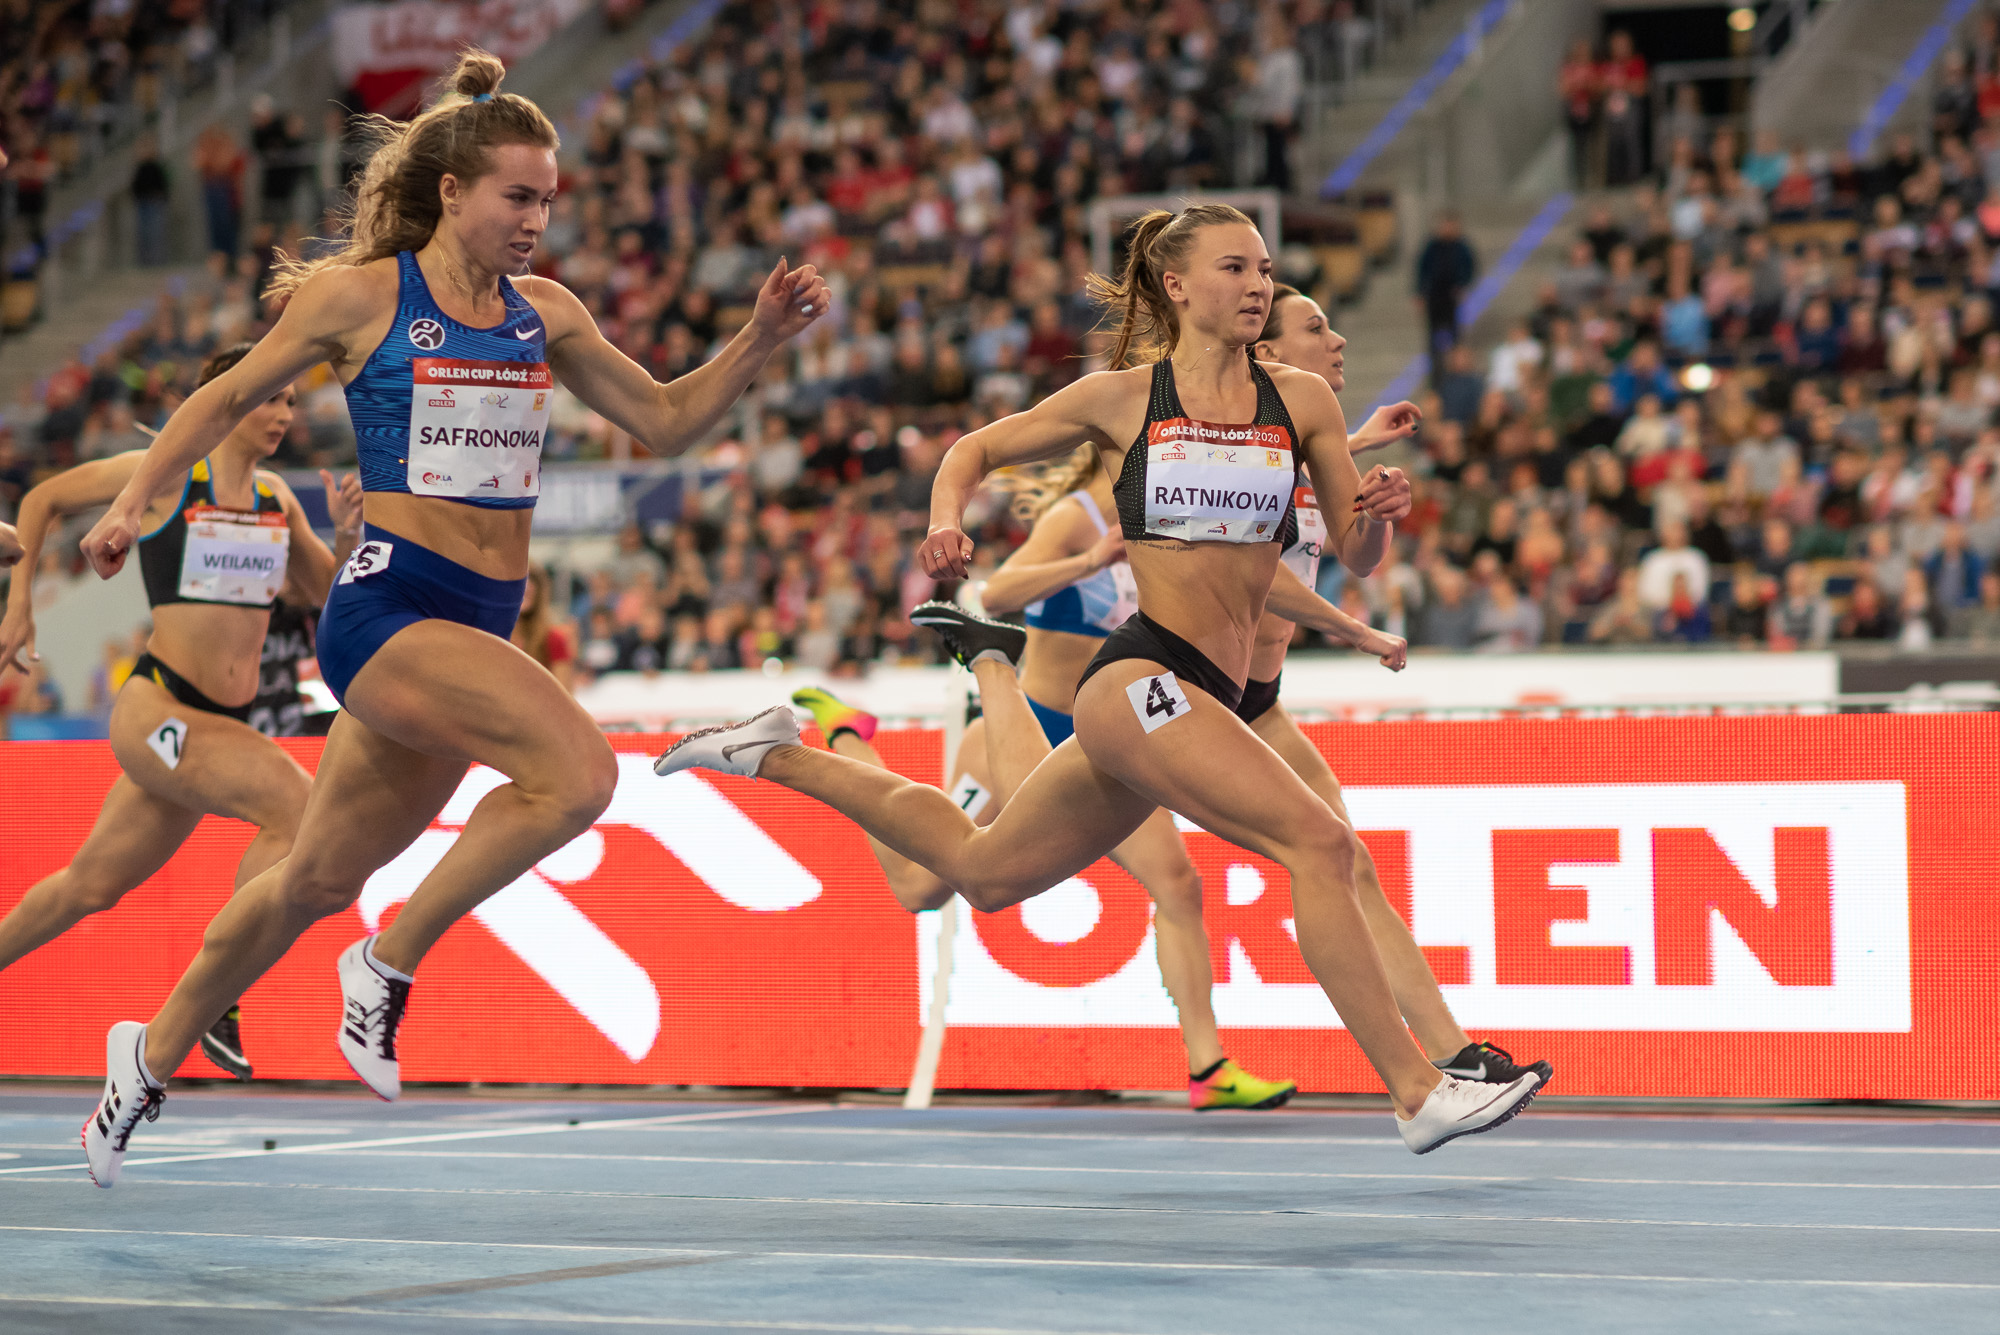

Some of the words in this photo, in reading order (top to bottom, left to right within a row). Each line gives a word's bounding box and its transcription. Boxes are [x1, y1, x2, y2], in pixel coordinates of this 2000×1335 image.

[428, 367, 469, 379] ORLEN
[471, 368, 494, 380] CUP
[496, 368, 528, 382] ŁÓDŹ
[529, 372, 547, 382] 2020
[420, 426, 540, 448] SAFRONOVA
[1160, 426, 1198, 437] ORLEN
[1200, 428, 1220, 439] CUP
[1221, 429, 1254, 440] ŁÓDŹ
[1255, 432, 1280, 443] 2020
[1155, 486, 1279, 512] RATNIKOVA
[203, 553, 275, 571] WEILAND
[1145, 676, 1177, 718] 4
